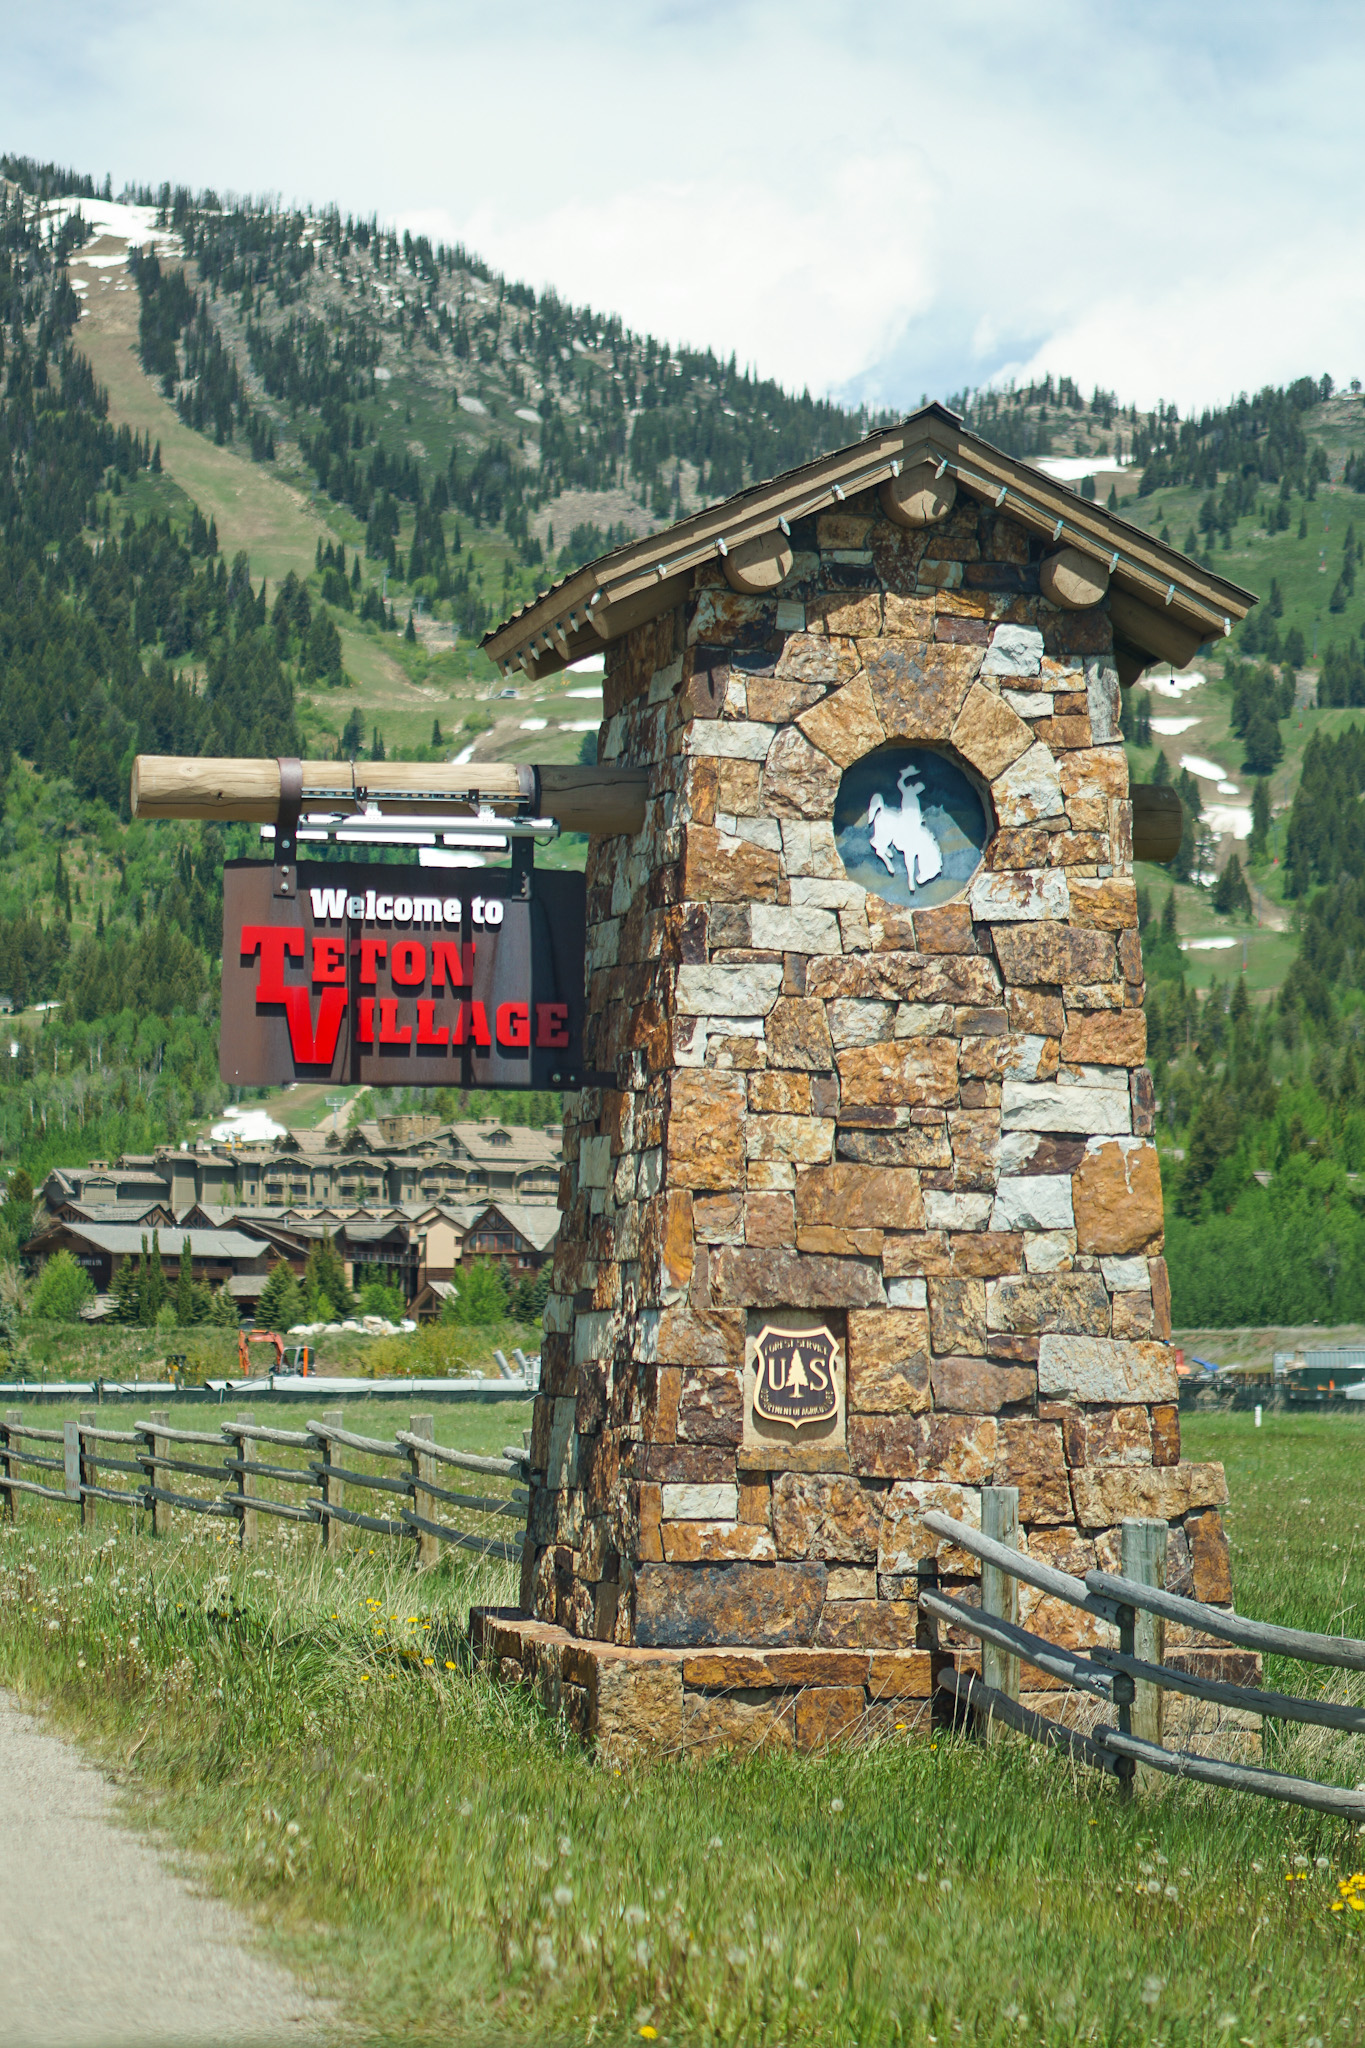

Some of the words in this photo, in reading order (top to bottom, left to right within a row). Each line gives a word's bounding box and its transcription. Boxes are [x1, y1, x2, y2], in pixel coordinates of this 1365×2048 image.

[310, 888, 462, 923] Welcome
[471, 895, 504, 925] to
[240, 925, 476, 1003] TETON
[285, 987, 569, 1064] VILLAGE
[764, 1338, 794, 1356] FOREST
[796, 1338, 828, 1356] SERVICE
